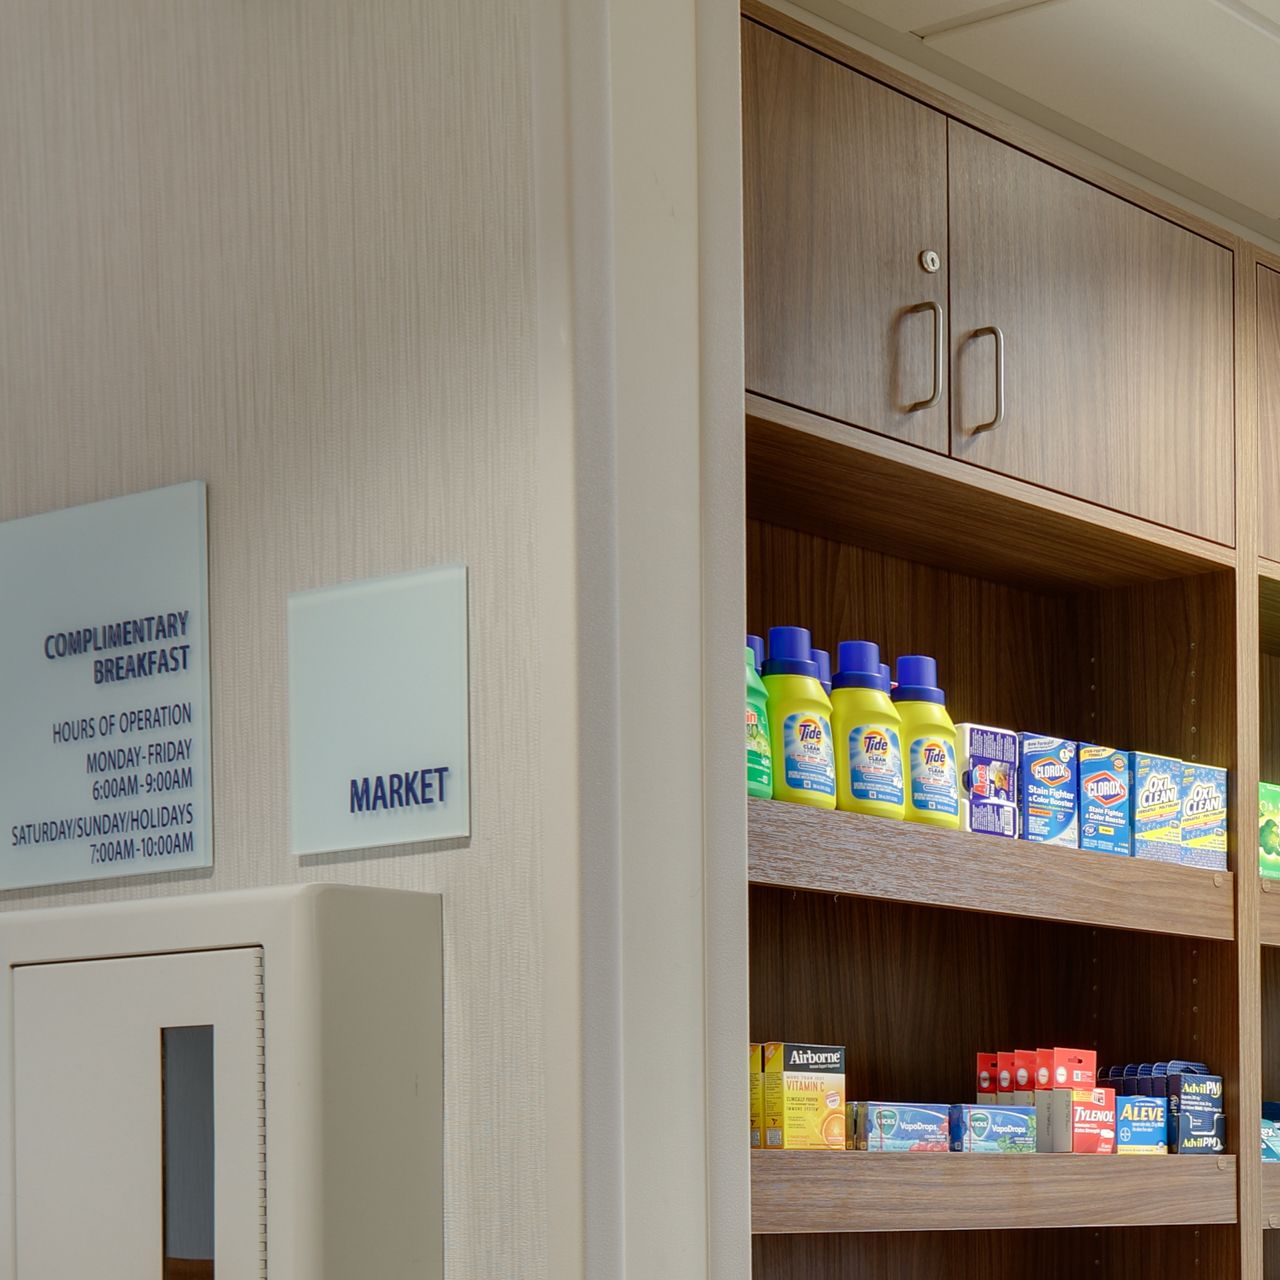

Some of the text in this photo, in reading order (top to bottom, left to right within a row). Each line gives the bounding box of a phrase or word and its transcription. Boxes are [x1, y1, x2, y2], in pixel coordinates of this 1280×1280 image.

[45, 611, 190, 660] COMPLIMENTARY
[94, 645, 190, 685] BREAKFAST
[53, 703, 192, 744] HOURS OF OPERATION
[800, 724, 821, 741] Tide
[864, 736, 887, 753] Tide
[86, 739, 192, 774] MONDAY-FRIDAY
[925, 748, 945, 764] Tide
[1035, 765, 1065, 778] CLOROX
[92, 767, 193, 801] 6:00AM-9:00AM
[350, 767, 448, 813] MARKET
[1088, 781, 1121, 797] CLOROX
[1150, 776, 1168, 792] OXI
[1029, 785, 1074, 800] Stain Fighter
[1142, 787, 1175, 807] CLEAN
[1194, 785, 1213, 800] OXI
[1033, 795, 1073, 807] Color Booster
[1186, 796, 1220, 816] CLEAN
[1089, 813, 1105, 821] Color
[1105, 809, 1124, 817] Fighter
[12, 803, 193, 846] SATURDAY/SUNDAY/HOLIDAYS
[90, 832, 194, 864] 7:00AM-10:00AM
[789, 1050, 840, 1064] Airborne
[787, 1080, 824, 1092] VITAMIN C
[1074, 1107, 1114, 1122] TYLENOL
[1120, 1103, 1165, 1121] ALEVE
[900, 1121, 937, 1132] VapoDrops
[992, 1124, 1026, 1134] VapoDrops
